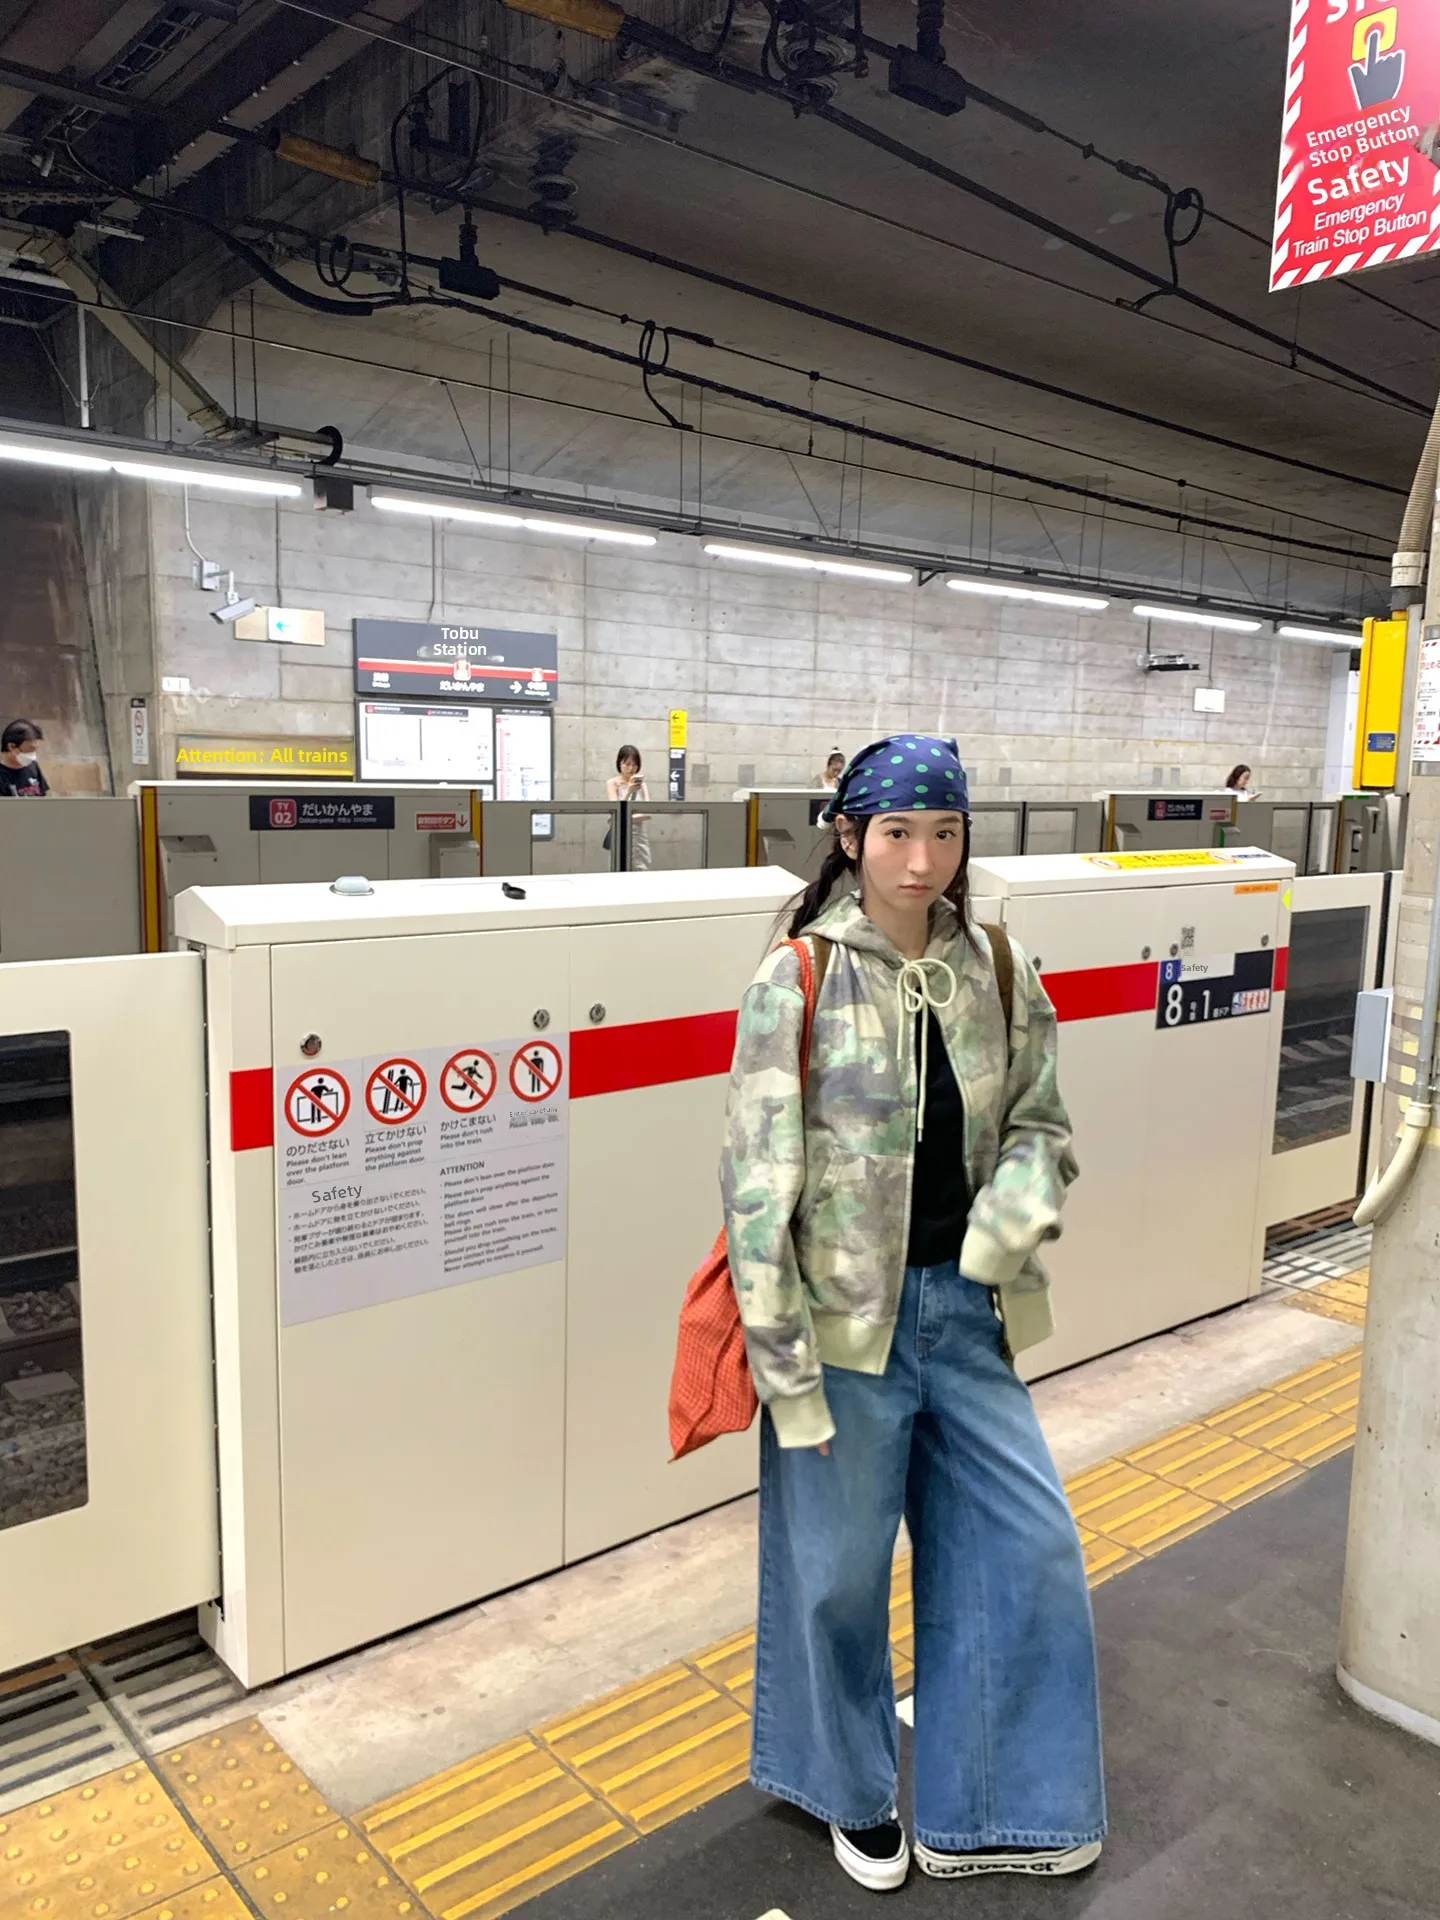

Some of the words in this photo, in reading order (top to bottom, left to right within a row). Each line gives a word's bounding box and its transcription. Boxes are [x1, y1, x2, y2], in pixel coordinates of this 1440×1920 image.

[1306, 106, 1411, 148] Emergency
[1309, 145, 1352, 168] Stop
[1356, 125, 1419, 154] Button
[1307, 156, 1409, 205] Safety
[1314, 193, 1405, 231] Emergency
[1293, 235, 1329, 258] Train
[1333, 225, 1370, 248] Stop
[1374, 210, 1427, 237] Button
[441, 627, 479, 640] Tobu
[433, 643, 487, 656] Station
[176, 748, 264, 763] Attention:
[270, 748, 293, 763] All
[298, 748, 348, 763] trains
[277, 803, 289, 811] TY
[302, 803, 374, 816] だいかんやま
[274, 812, 292, 824] 02
[1165, 962, 1173, 980] 8
[1181, 964, 1208, 973] Safety
[1165, 984, 1182, 1025] 8
[1203, 989, 1210, 1020] 1
[440, 1114, 496, 1132] かけこまない
[365, 1125, 427, 1144] 立てかけない
[440, 1132, 460, 1141] Please
[462, 1128, 479, 1137] don't
[286, 1138, 350, 1157] のりださない
[365, 1146, 386, 1154] Please
[388, 1141, 405, 1149] don't
[407, 1139, 423, 1148] prop
[286, 1159, 309, 1167] Please
[311, 1154, 330, 1163] don't
[332, 1152, 347, 1160] lean
[365, 1153, 395, 1162] anything
[397, 1148, 421, 1157] against
[286, 1168, 303, 1177] over
[305, 1165, 317, 1173] the
[318, 1160, 350, 1172] platform
[378, 1159, 407, 1170] platform
[440, 1161, 485, 1176] ATTENTION
[311, 1186, 363, 1203] Safety
